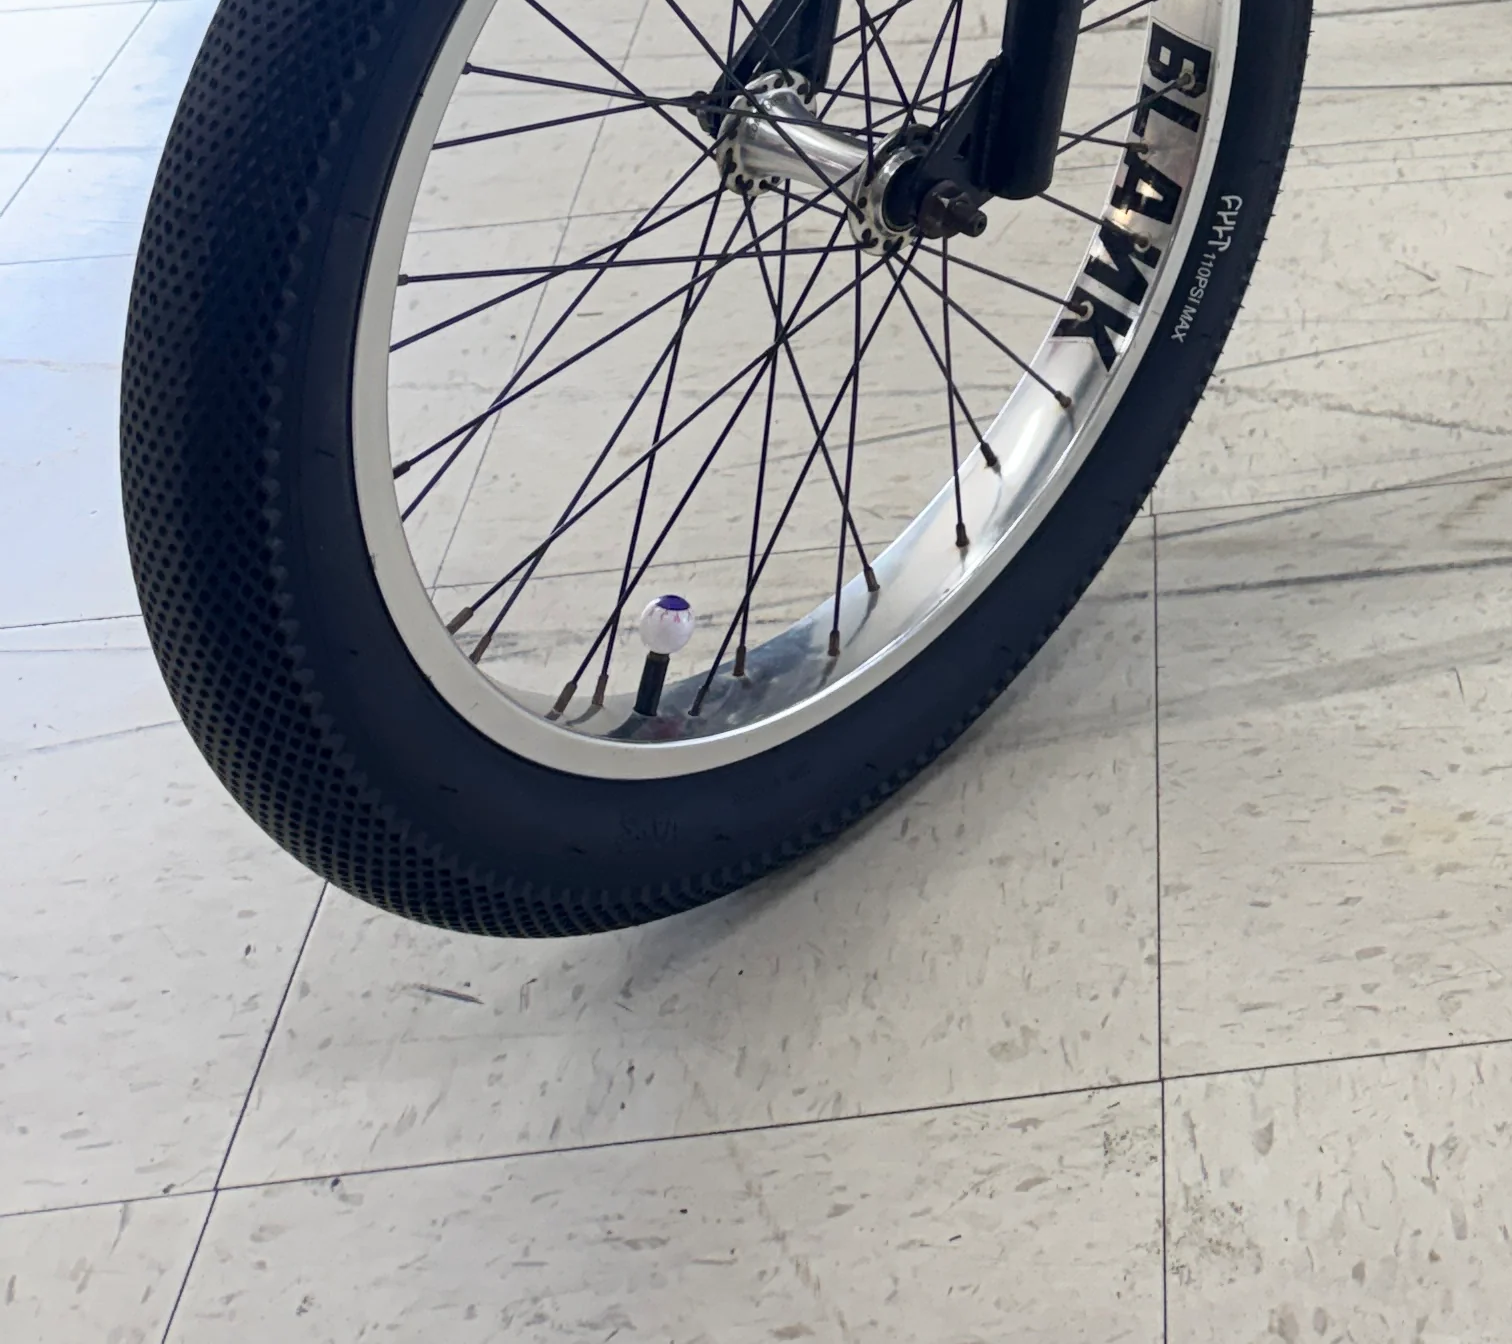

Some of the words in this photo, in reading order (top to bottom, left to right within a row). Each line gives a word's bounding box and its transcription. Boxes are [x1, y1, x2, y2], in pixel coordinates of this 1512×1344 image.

[1051, 21, 1213, 373] BLANK
[1187, 252, 1217, 307] 110PSI
[1171, 305, 1198, 343] MAX
